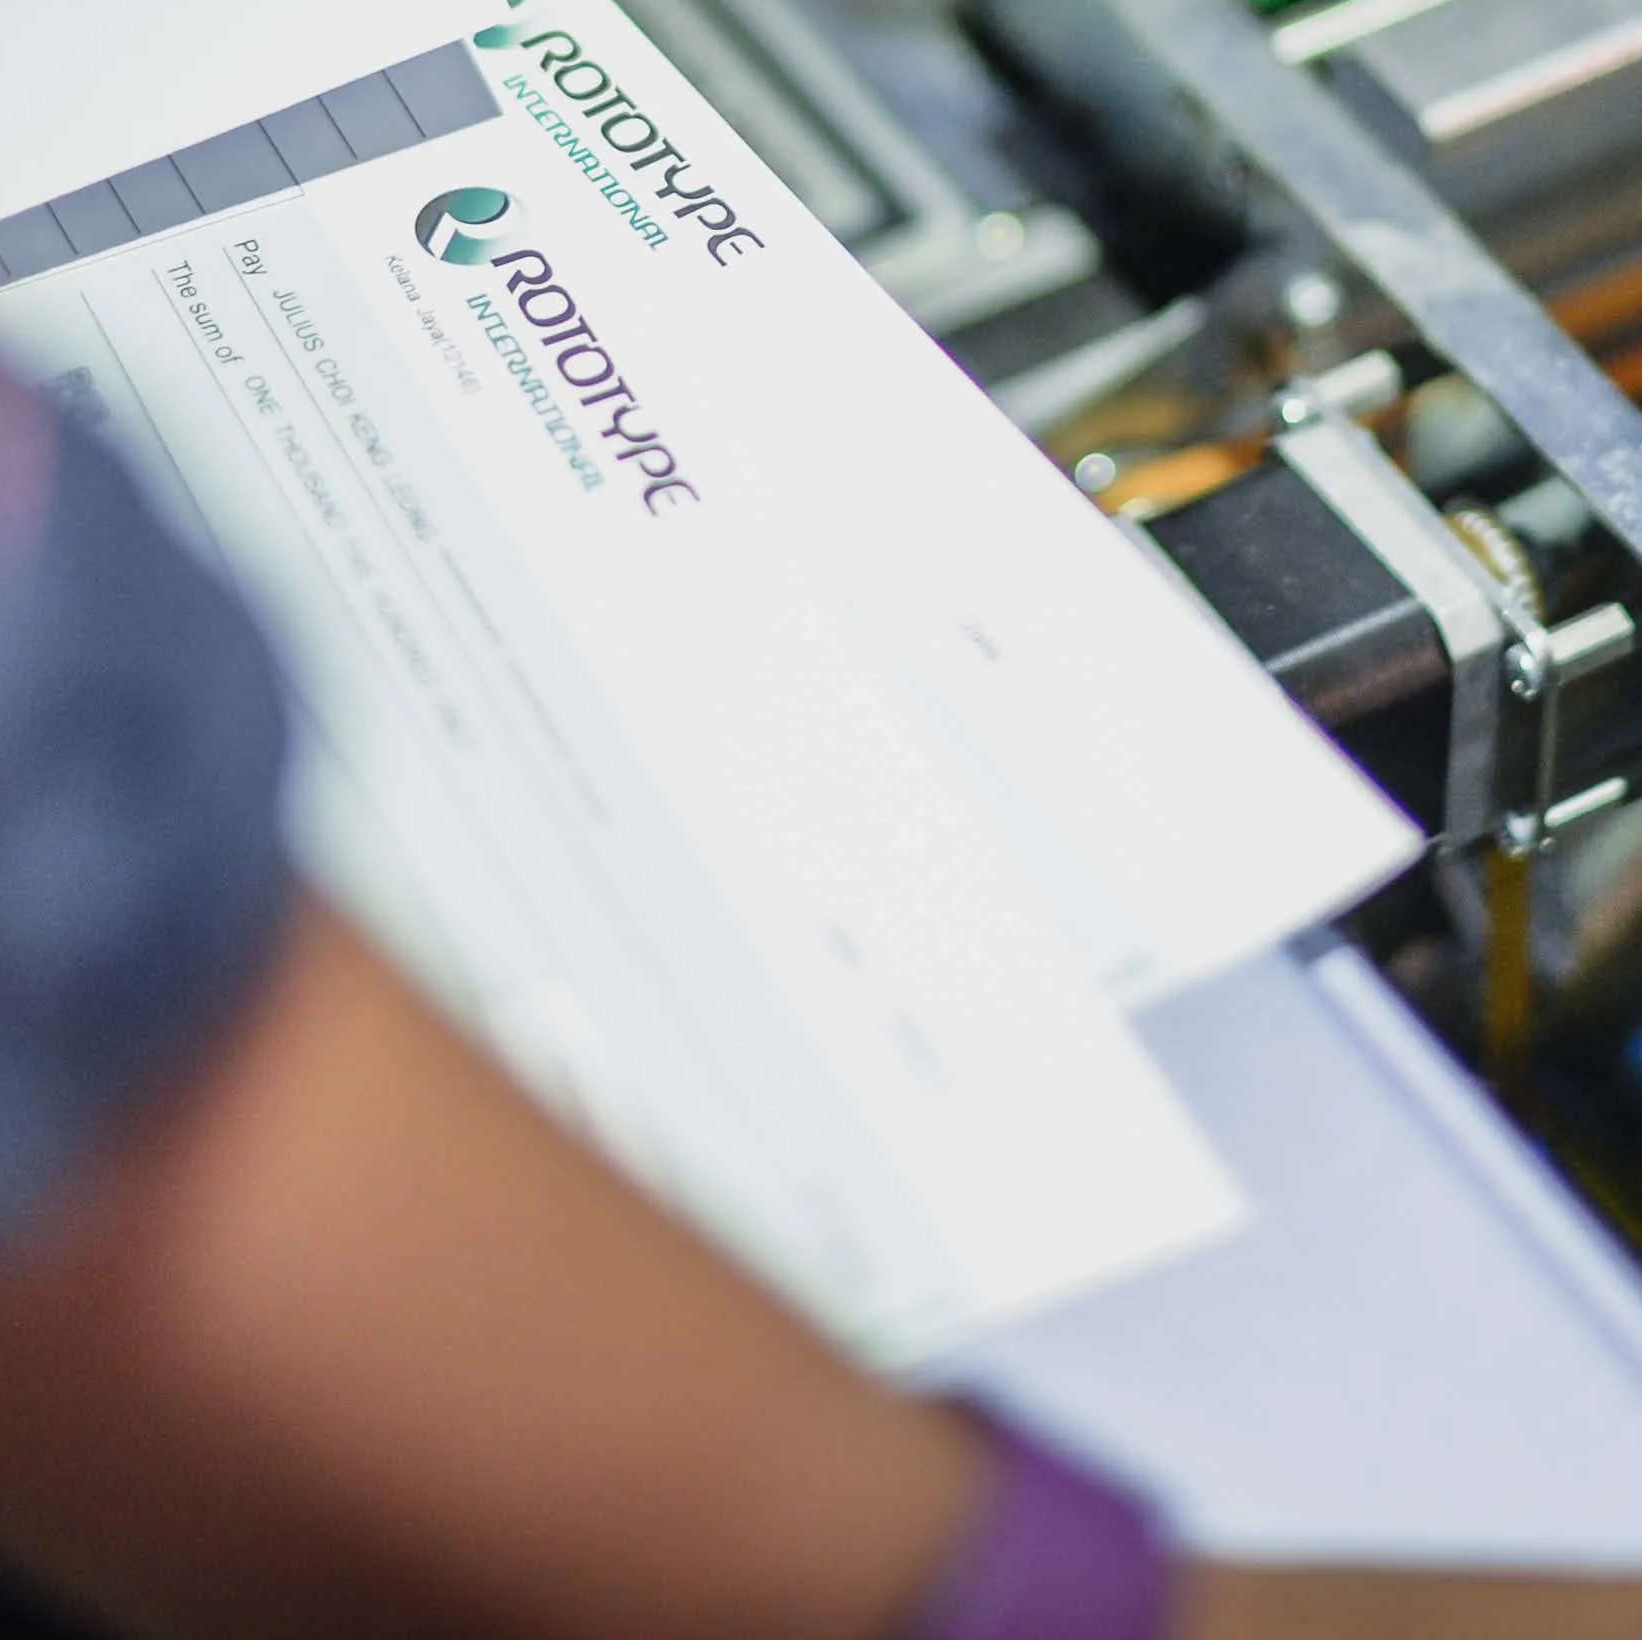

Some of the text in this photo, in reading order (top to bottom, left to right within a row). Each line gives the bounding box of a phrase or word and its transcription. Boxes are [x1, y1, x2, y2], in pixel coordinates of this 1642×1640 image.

[502, 73, 669, 251] INTERNATIONAL
[520, 29, 766, 267] ROTOTYPE
[167, 260, 198, 298] The
[188, 301, 224, 343] sum
[213, 345, 245, 365] of
[244, 374, 283, 416] ONE
[234, 238, 268, 276] Pay
[272, 289, 325, 353] JULIUS
[314, 357, 357, 408] CHOI
[385, 254, 421, 303] Kelana
[466, 293, 605, 494] INTERNATIONAL
[489, 248, 701, 516] ROTOTYPE
